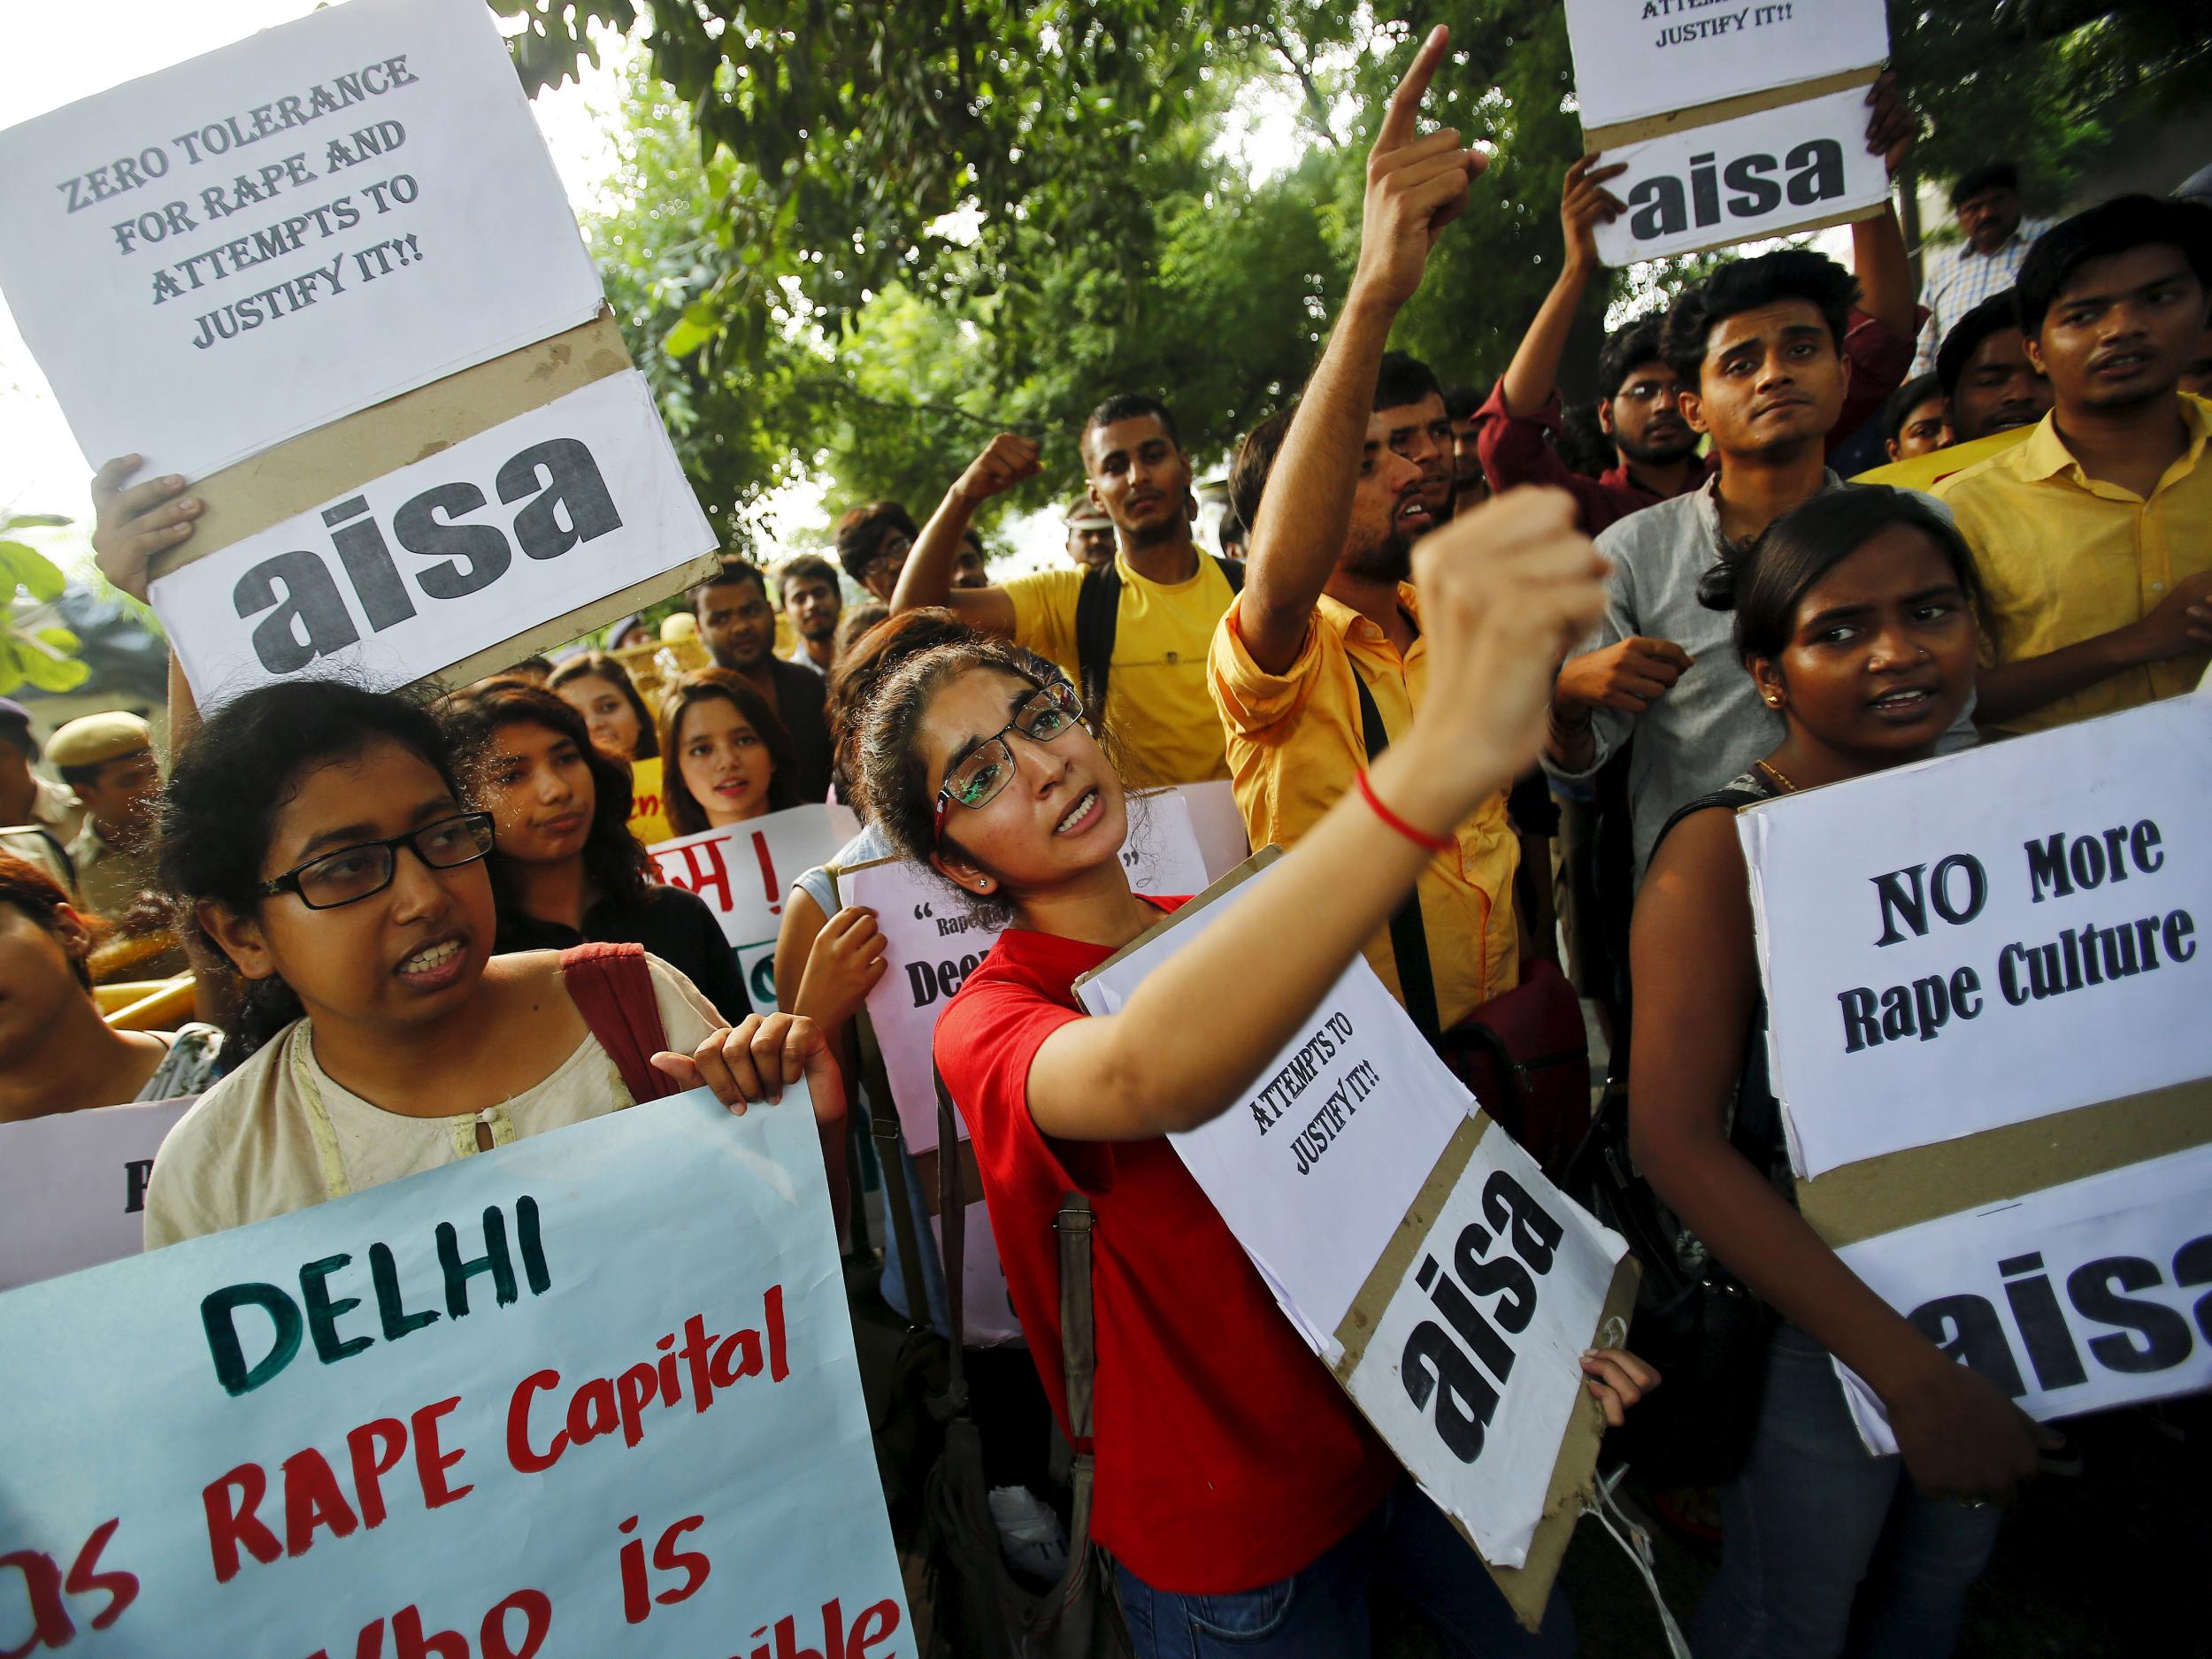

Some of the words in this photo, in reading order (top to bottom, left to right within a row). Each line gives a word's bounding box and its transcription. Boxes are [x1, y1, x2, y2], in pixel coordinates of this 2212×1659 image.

[1655, 7, 1749, 48] JUSTIFY
[1755, 3, 1793, 27] IT!!
[58, 148, 170, 214] ZERO
[173, 55, 419, 166] TOLERANCE
[111, 203, 197, 256] FOR
[203, 153, 319, 222] RAPE
[326, 119, 406, 173] AND
[1629, 139, 1845, 241] aisa
[151, 197, 359, 305] ATTEMPTS
[362, 173, 419, 214] TO
[193, 255, 343, 349] JUSTIFY
[354, 233, 423, 283] IT!!
[232, 437, 623, 675] aisa
[1869, 853, 1988, 947] NO
[2024, 818, 2164, 903] More
[905, 949, 989, 1008] Dee
[1837, 965, 1983, 1055] Rape
[1998, 909, 2196, 1007] Culture
[1248, 1030, 1336, 1136] ATTEMPTS
[1325, 1011, 1354, 1045] TO
[1290, 1077, 1356, 1175] JUSTIFY
[1345, 1059, 1380, 1102] IT!!
[200, 1194, 551, 1397] DELHI
[1401, 1170, 1564, 1464] aisa
[203, 1395, 474, 1584] RAPE
[505, 1285, 788, 1473] Capital
[618, 1515, 710, 1624] is
